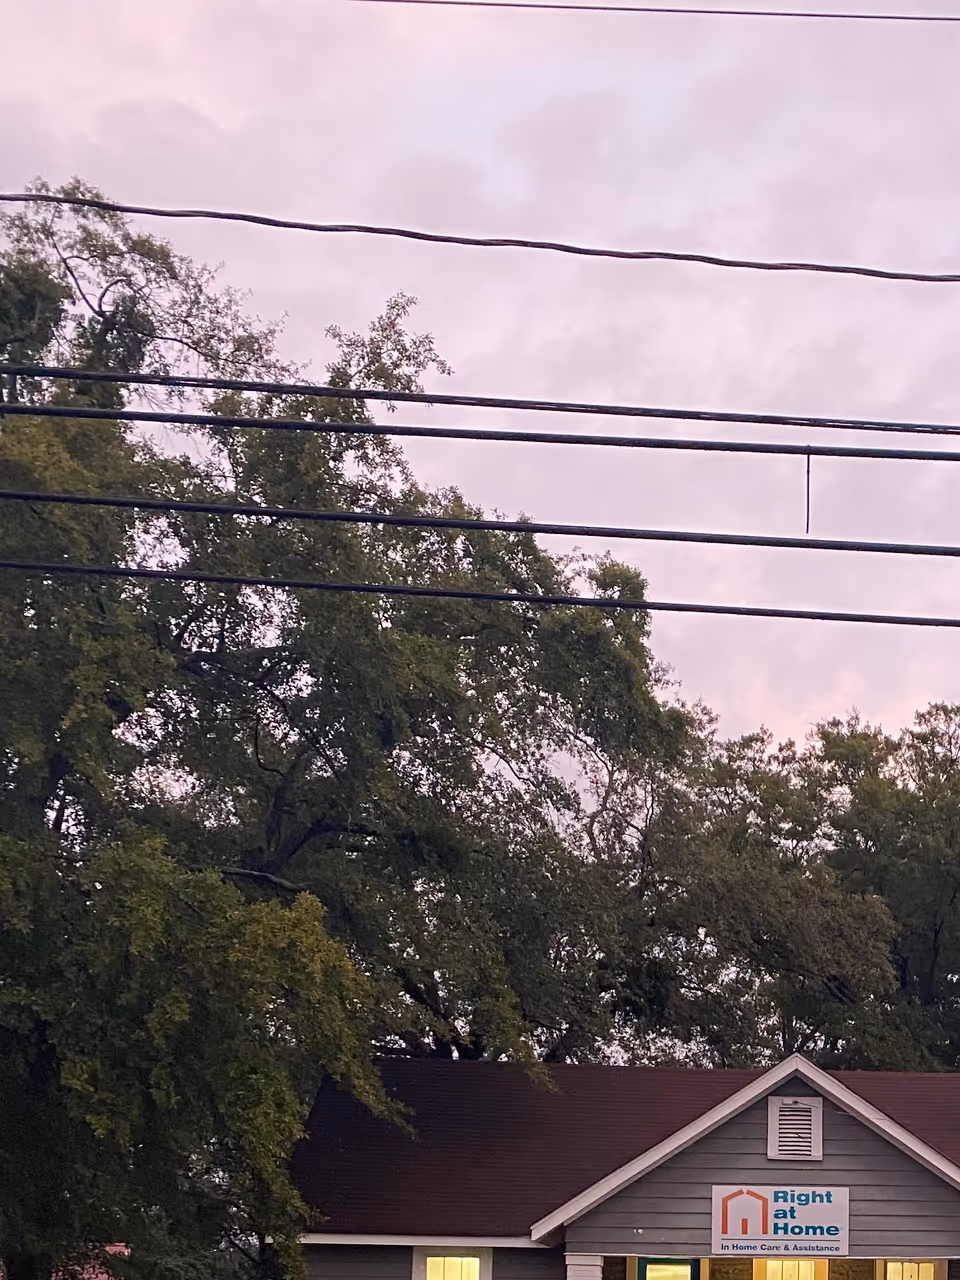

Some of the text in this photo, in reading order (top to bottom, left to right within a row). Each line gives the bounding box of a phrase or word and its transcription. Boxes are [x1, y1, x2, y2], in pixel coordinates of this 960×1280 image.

[773, 1190, 832, 1206] Right
[773, 1206, 796, 1219] at
[773, 1222, 840, 1236] Home
[721, 1243, 729, 1251] In
[732, 1243, 757, 1251] Home
[760, 1243, 780, 1251] Care
[792, 1244, 840, 1252] Assistance
